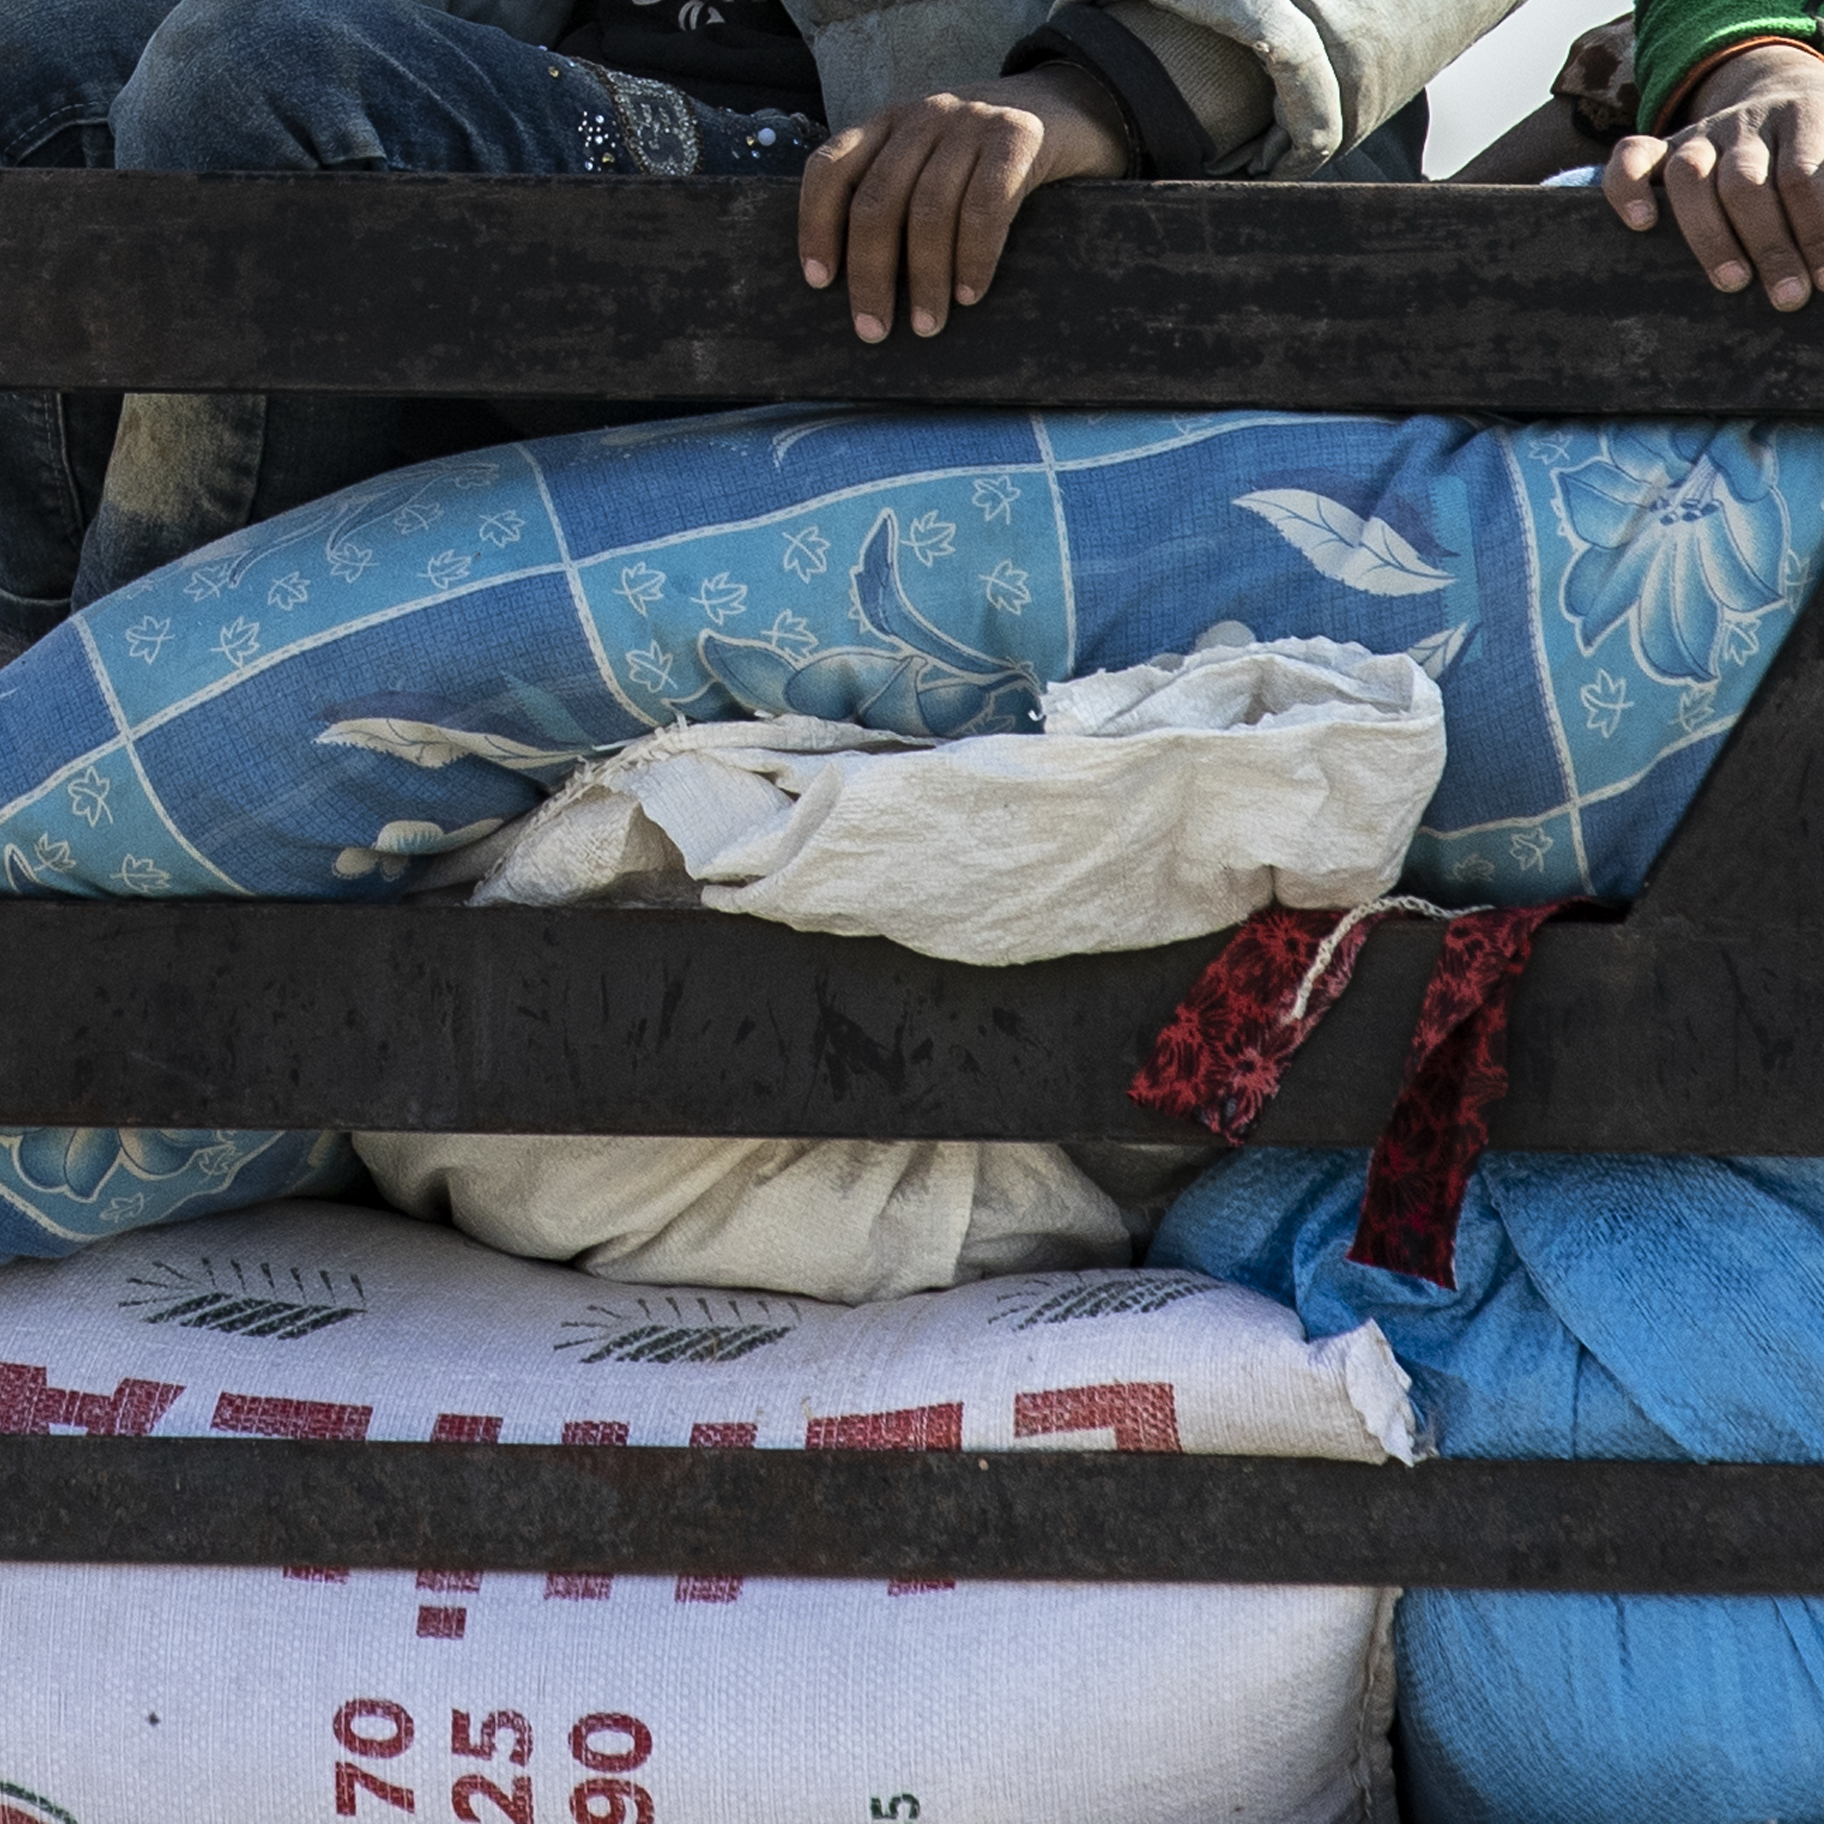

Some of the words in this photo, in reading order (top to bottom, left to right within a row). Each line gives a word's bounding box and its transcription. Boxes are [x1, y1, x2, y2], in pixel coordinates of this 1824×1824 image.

[333, 1698, 415, 1816] 70
[451, 1707, 533, 1824] 25
[569, 1711, 654, 1824] 90
